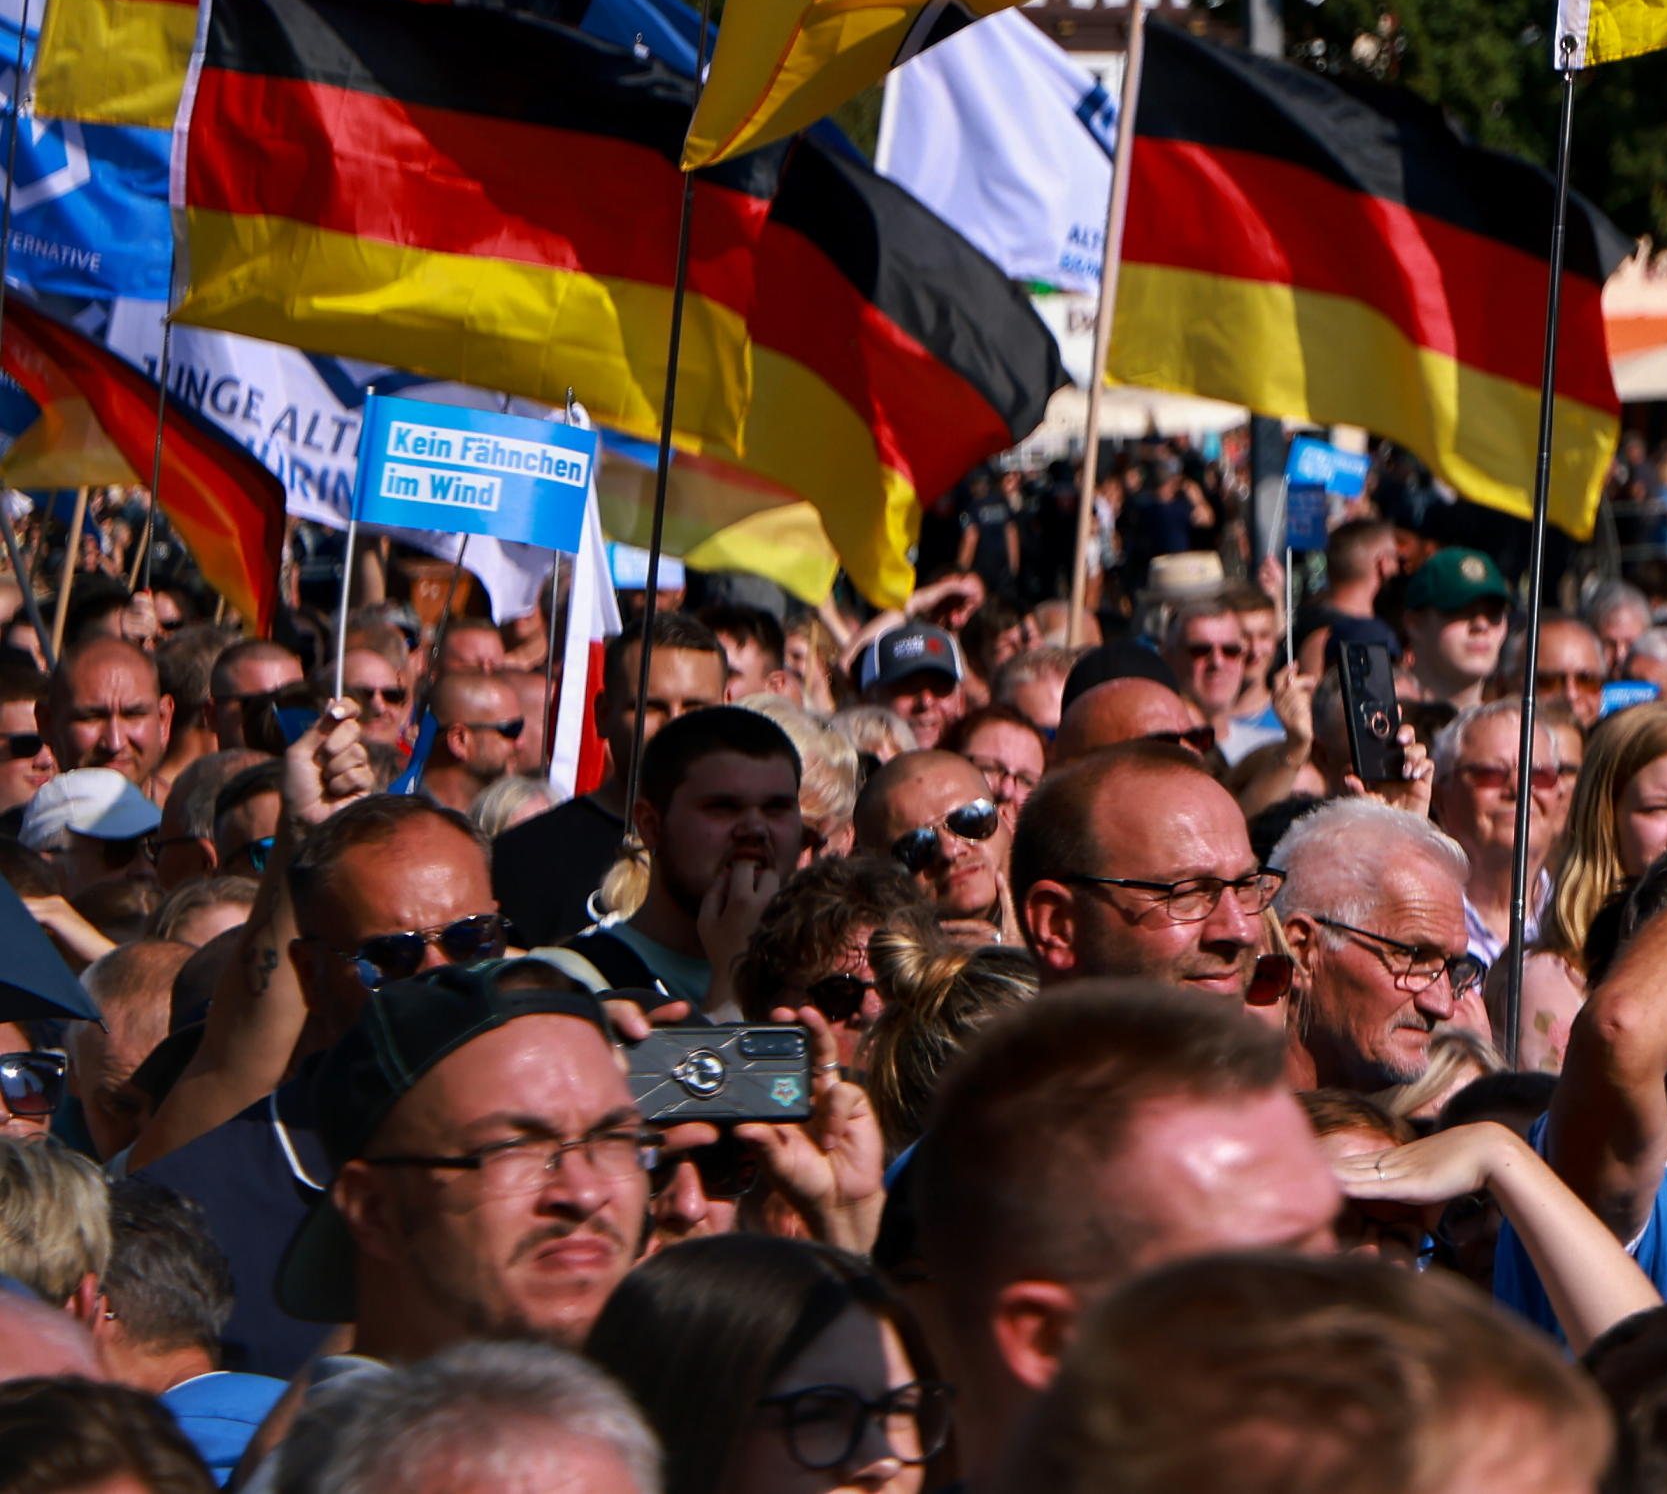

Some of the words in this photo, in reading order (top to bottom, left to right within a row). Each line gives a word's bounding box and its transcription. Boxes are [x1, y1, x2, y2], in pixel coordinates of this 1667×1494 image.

[392, 426, 453, 460] Kein
[459, 436, 582, 483] Fähnchen
[387, 468, 419, 498] im
[429, 473, 496, 507] Wind
